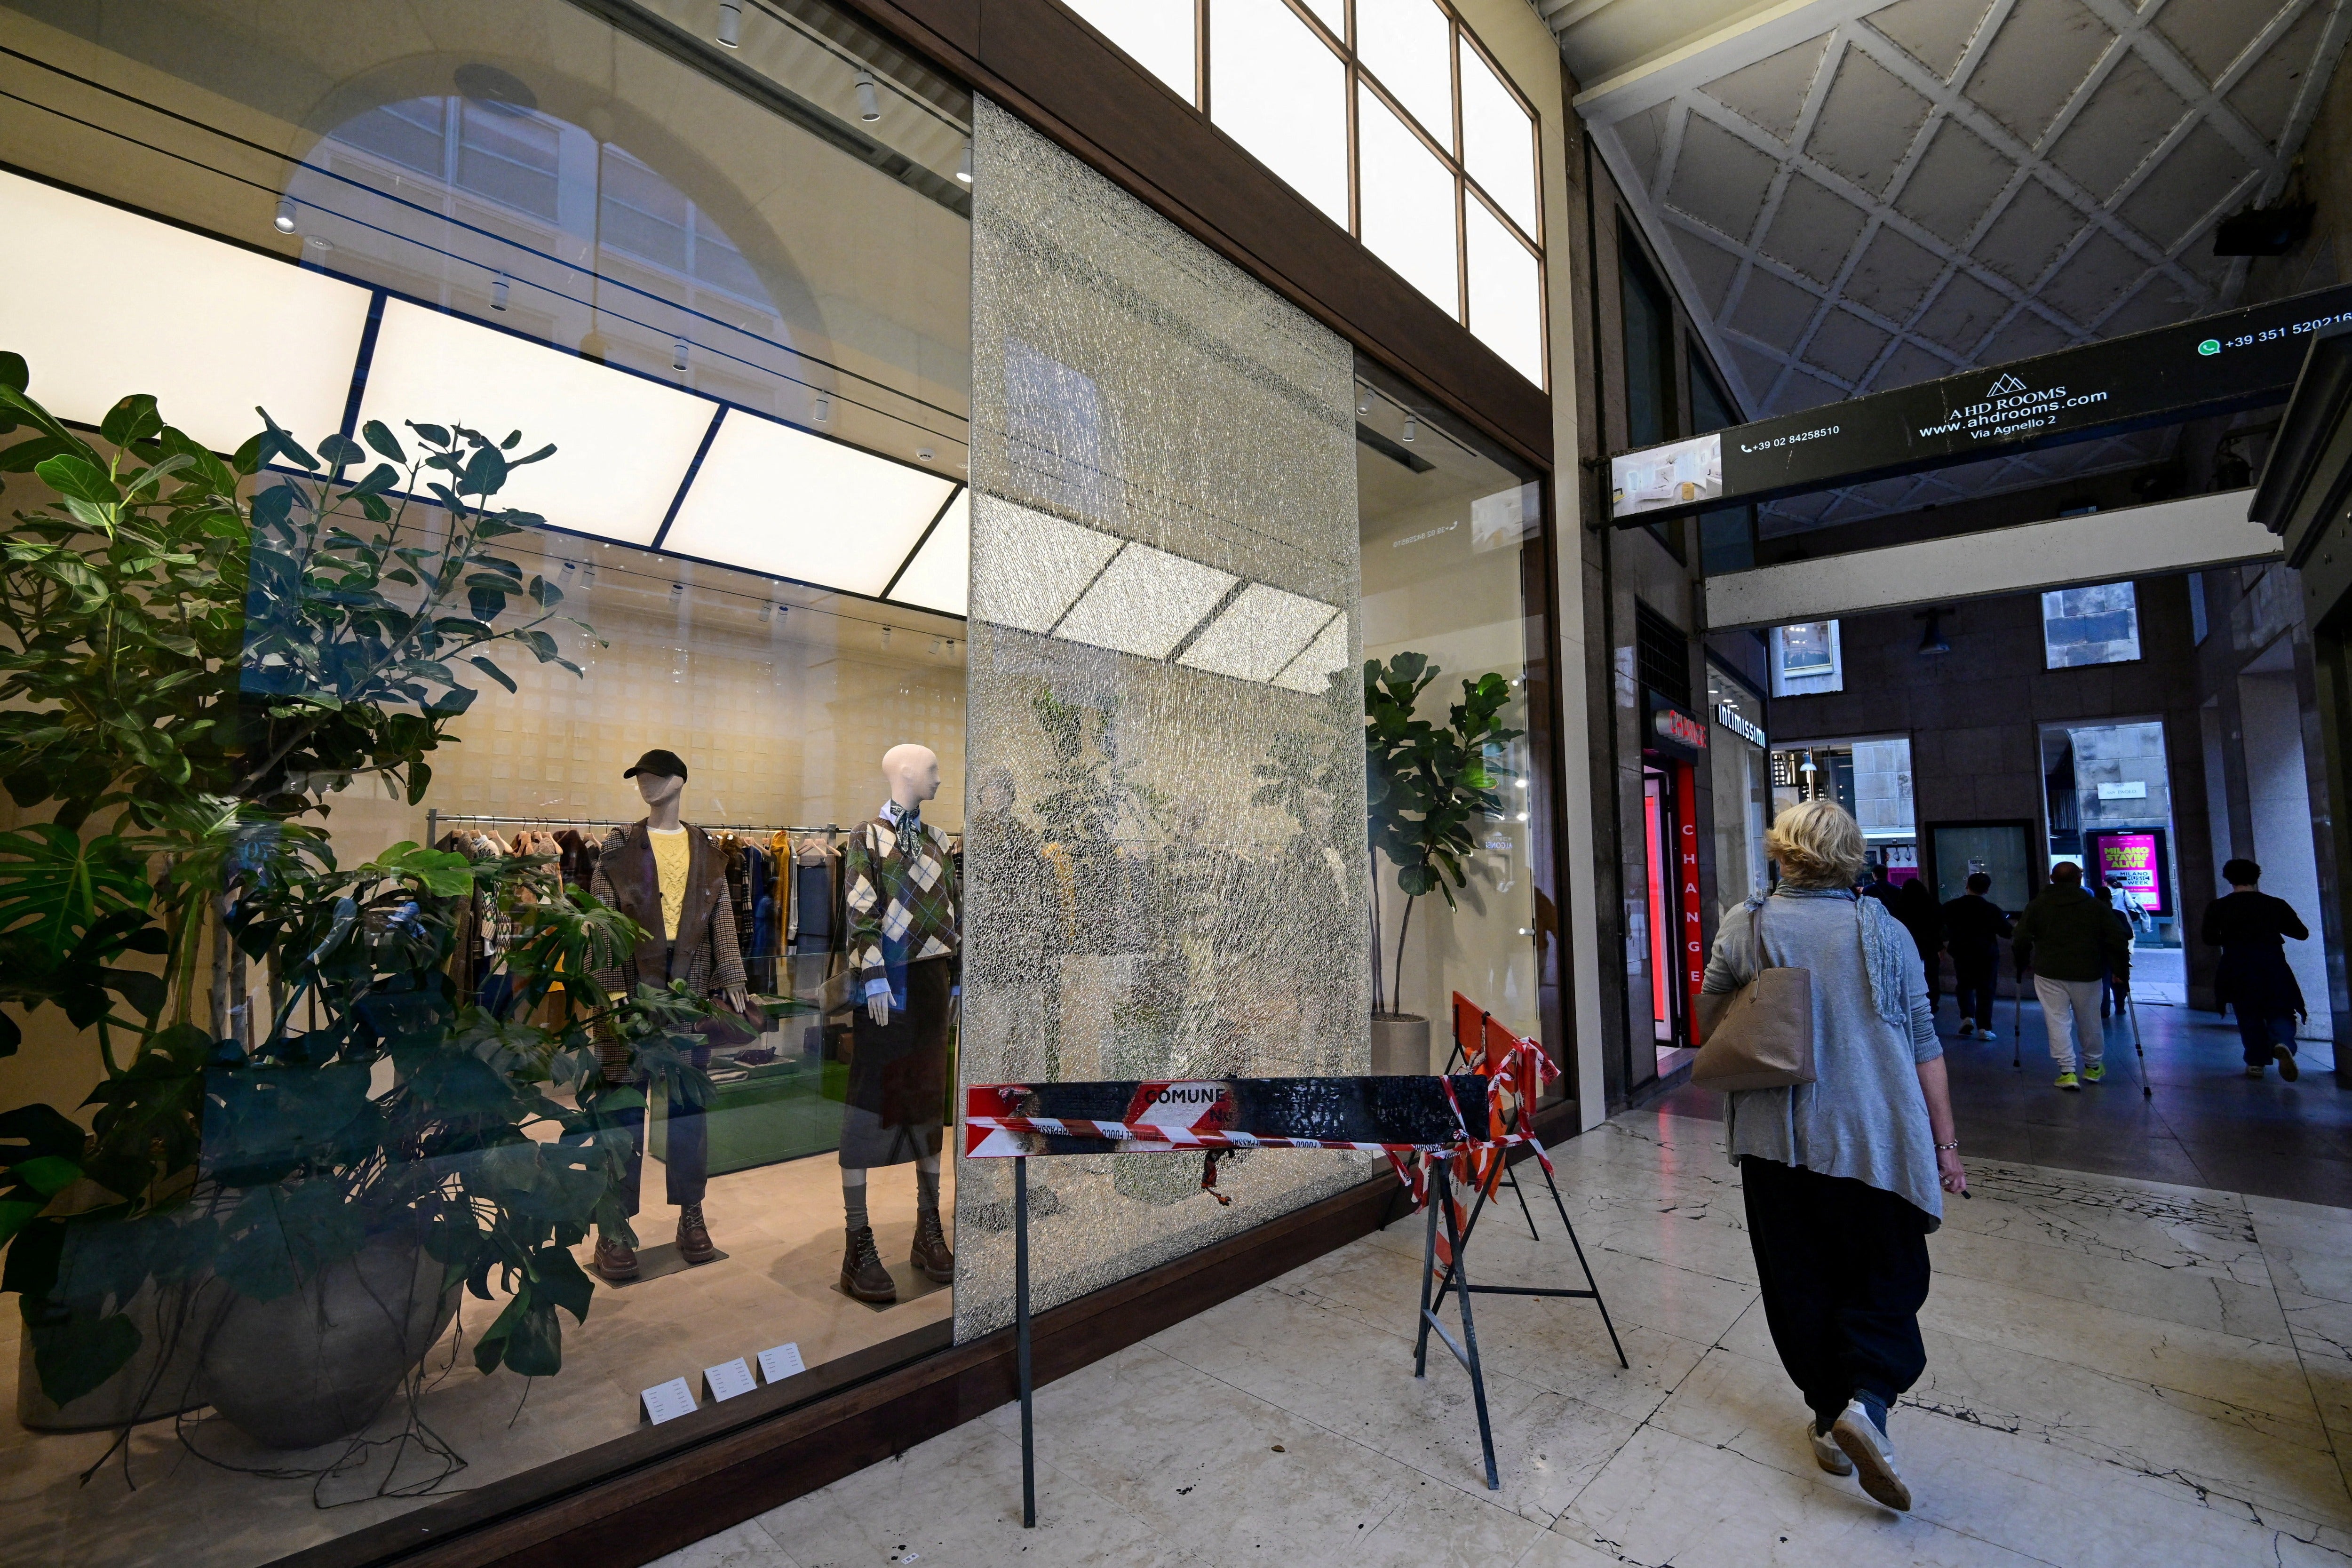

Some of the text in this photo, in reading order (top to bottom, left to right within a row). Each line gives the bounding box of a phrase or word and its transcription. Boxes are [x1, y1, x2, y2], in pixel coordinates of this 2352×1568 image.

[2225, 335, 2253, 348] +39
[2258, 328, 2285, 342] 351
[1919, 391, 2107, 438] www.ahdrooms.com
[1949, 386, 2067, 420] AHD ROOMS
[1752, 426, 1839, 451] +39 02 84258510
[1971, 415, 2057, 440] Via Agnello 2
[1669, 709, 1707, 748] CHANGE
[1718, 703, 1766, 748] intimissimi
[1682, 825, 1700, 982] CHANGE
[1145, 1088, 1226, 1105] COMUNE
